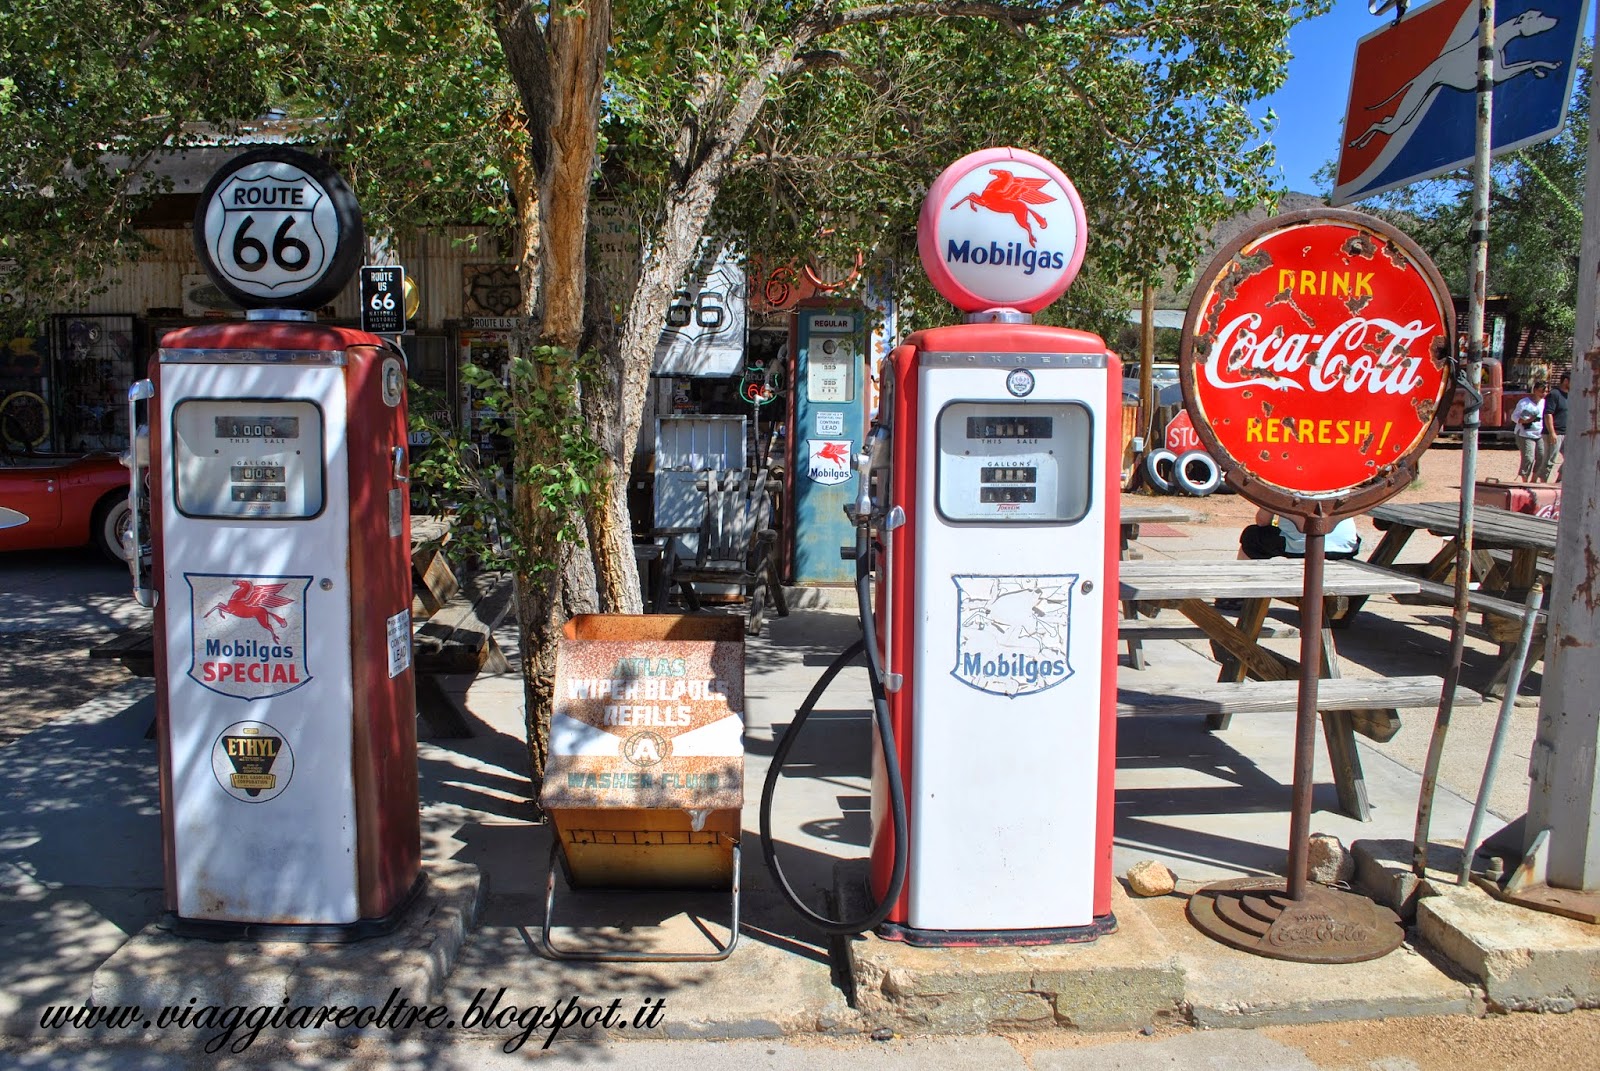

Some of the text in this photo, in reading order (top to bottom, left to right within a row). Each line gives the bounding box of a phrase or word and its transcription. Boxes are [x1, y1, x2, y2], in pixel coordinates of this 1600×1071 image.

[234, 187, 303, 205] ROUTE
[233, 215, 310, 272] 66
[947, 239, 1064, 276] Mobilgas
[371, 272, 393, 281] ROUTE
[378, 282, 387, 291] US
[1278, 269, 1375, 296] DRINK
[371, 292, 395, 310] 66
[474, 319, 497, 328] ROUTE
[814, 320, 848, 328] REGULAR
[1204, 313, 1436, 394] Coca-Cola
[1168, 427, 1200, 448] STO
[811, 467, 849, 480] Mobilgas
[206, 639, 293, 662] Mobilgas
[394, 646, 407, 662] LEAD
[203, 661, 300, 683] SPECIAL
[612, 657, 686, 677] ATLAS
[963, 652, 1065, 683] Mobilgas
[567, 679, 729, 701] WIPER BLADES
[604, 705, 692, 727] REFILLS
[227, 738, 276, 757] ETHYL
[567, 772, 720, 789] WASHER FLUID
